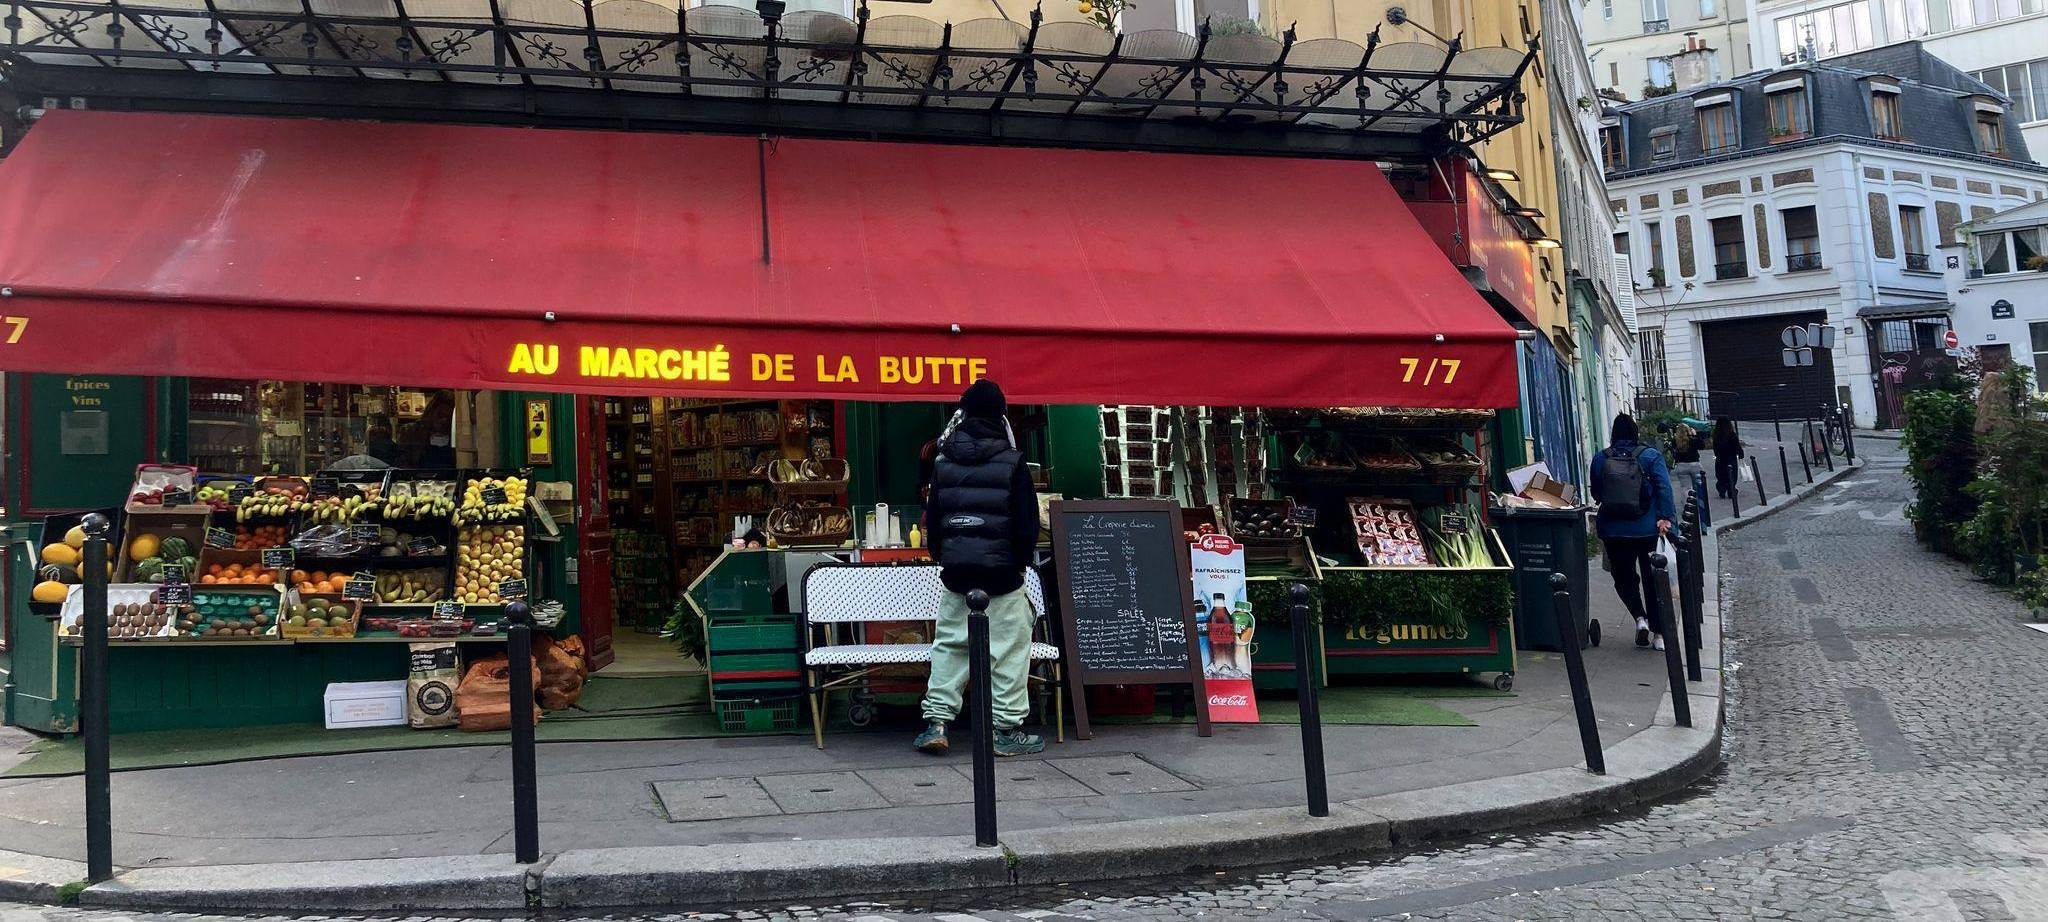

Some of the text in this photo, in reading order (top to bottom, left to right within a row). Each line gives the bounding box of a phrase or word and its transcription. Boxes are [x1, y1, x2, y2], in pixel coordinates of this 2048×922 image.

[508, 343, 559, 375] AU
[580, 344, 730, 382] MARCHÉ
[751, 353, 795, 382] DE
[816, 354, 860, 383] LA
[1400, 357, 1461, 386] 7/7
[71, 395, 101, 406] Vins
